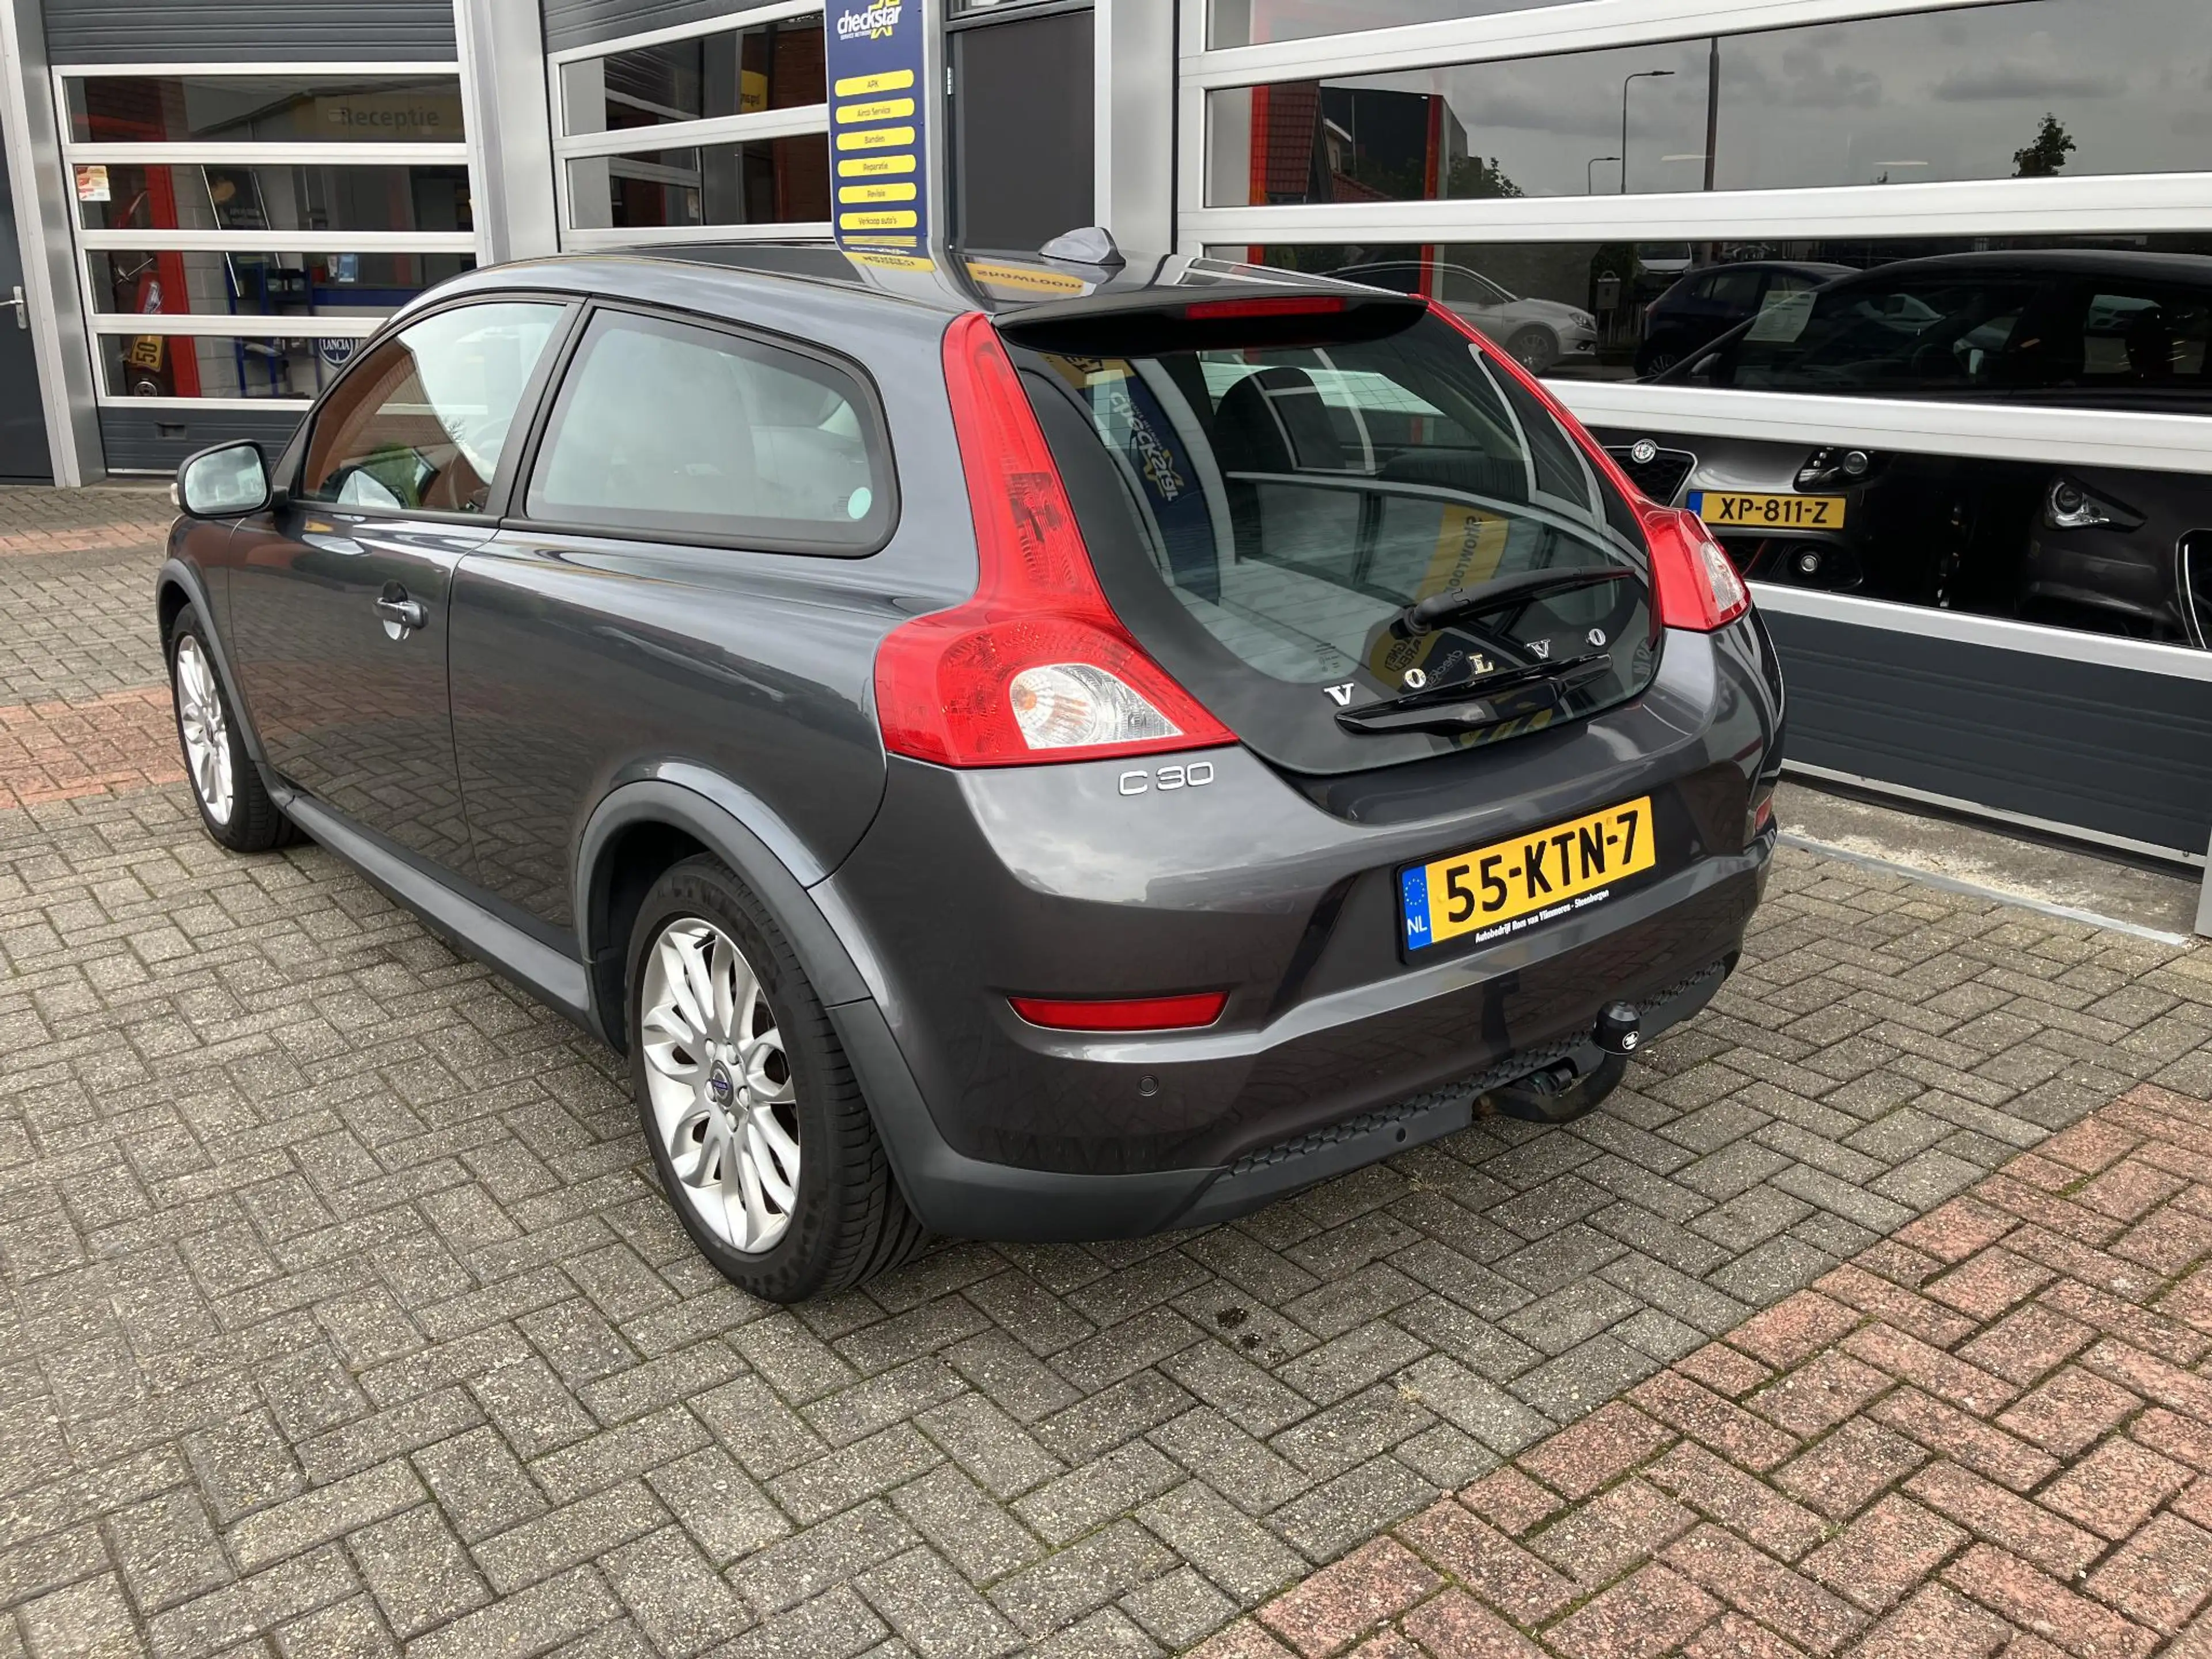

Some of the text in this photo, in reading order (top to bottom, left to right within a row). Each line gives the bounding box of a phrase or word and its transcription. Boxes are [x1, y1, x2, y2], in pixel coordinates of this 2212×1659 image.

[837, 6, 902, 34] checkstar
[867, 80, 879, 88] APK
[340, 106, 440, 131] Receptie
[872, 107, 891, 115] Service
[865, 135, 885, 144] Banden
[863, 162, 888, 172] Reparatie
[867, 190, 885, 198] Revisie
[858, 217, 880, 226] Verkoop
[323, 339, 350, 350] LANCIA
[1719, 497, 1830, 524] XP-811-Z
[1324, 628, 1607, 707] VOLVO
[1446, 810, 1638, 923] 55-KTN-7
[1475, 923, 1511, 944] Autobedrijf
[1527, 915, 1539, 925] van
[1574, 889, 1609, 908] Steenbergen
[1407, 915, 1427, 936] NL
